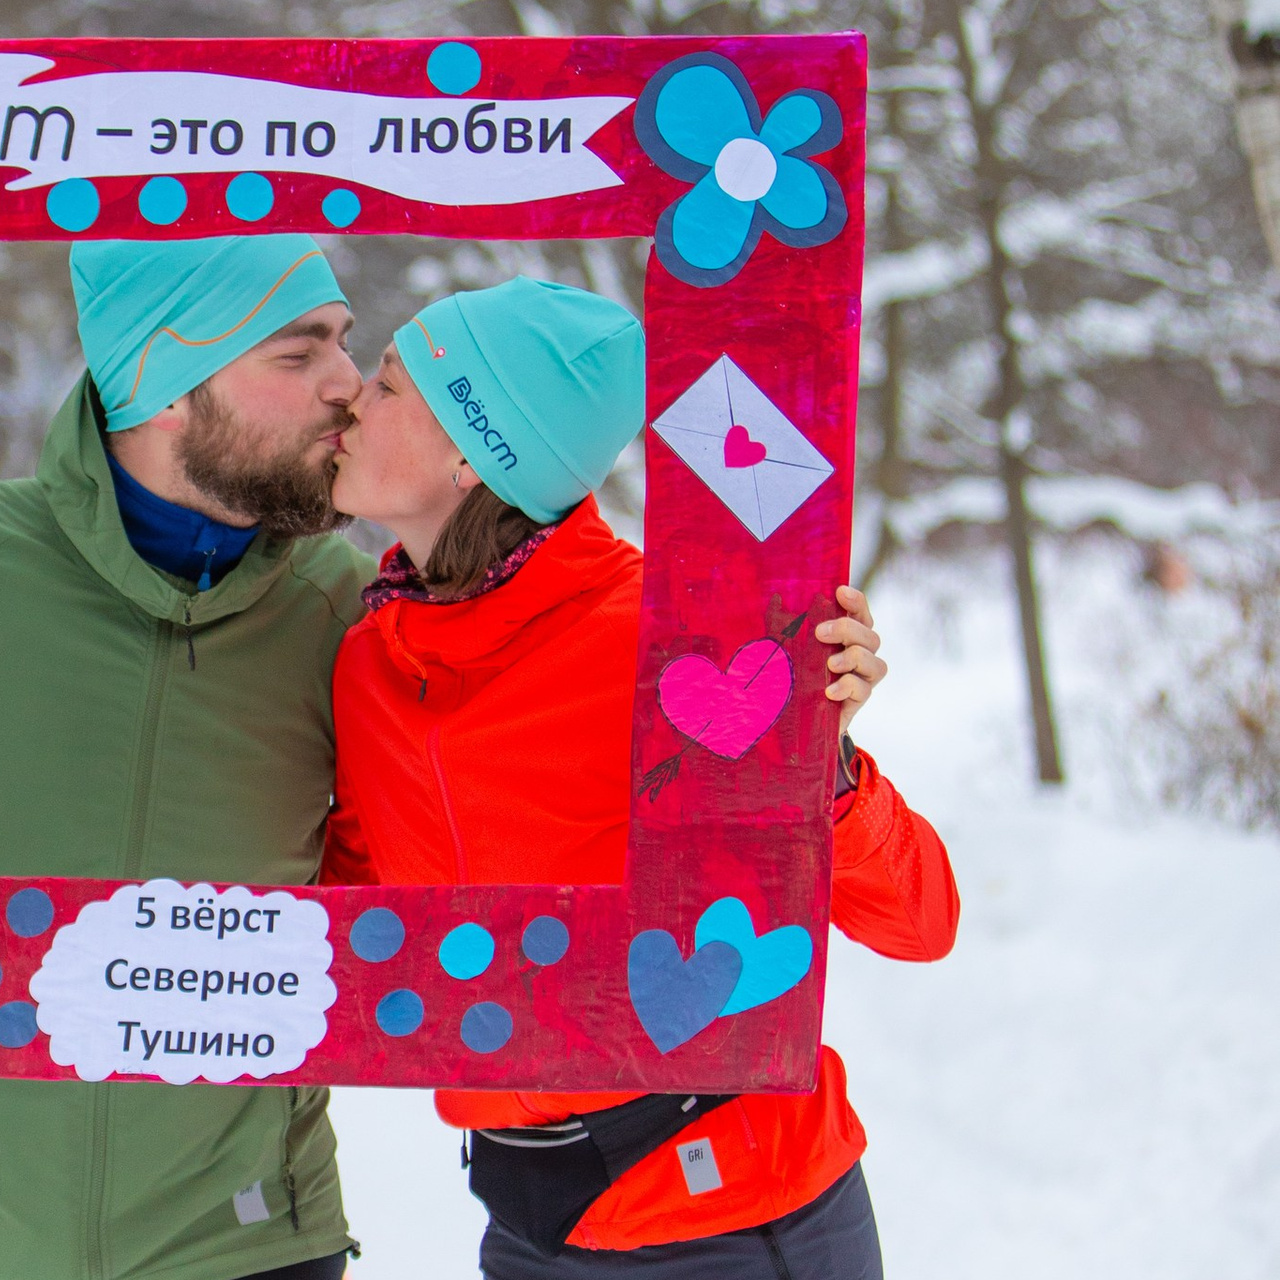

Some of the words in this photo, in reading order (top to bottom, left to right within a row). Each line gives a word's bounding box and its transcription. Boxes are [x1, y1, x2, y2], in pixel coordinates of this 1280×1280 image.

[149, 118, 244, 156] это
[265, 120, 336, 158] по
[368, 101, 572, 154] любви
[134, 896, 156, 929] 5
[170, 897, 281, 940] вёрст
[104, 958, 300, 1001] Северное
[117, 1020, 275, 1061] Тушино
